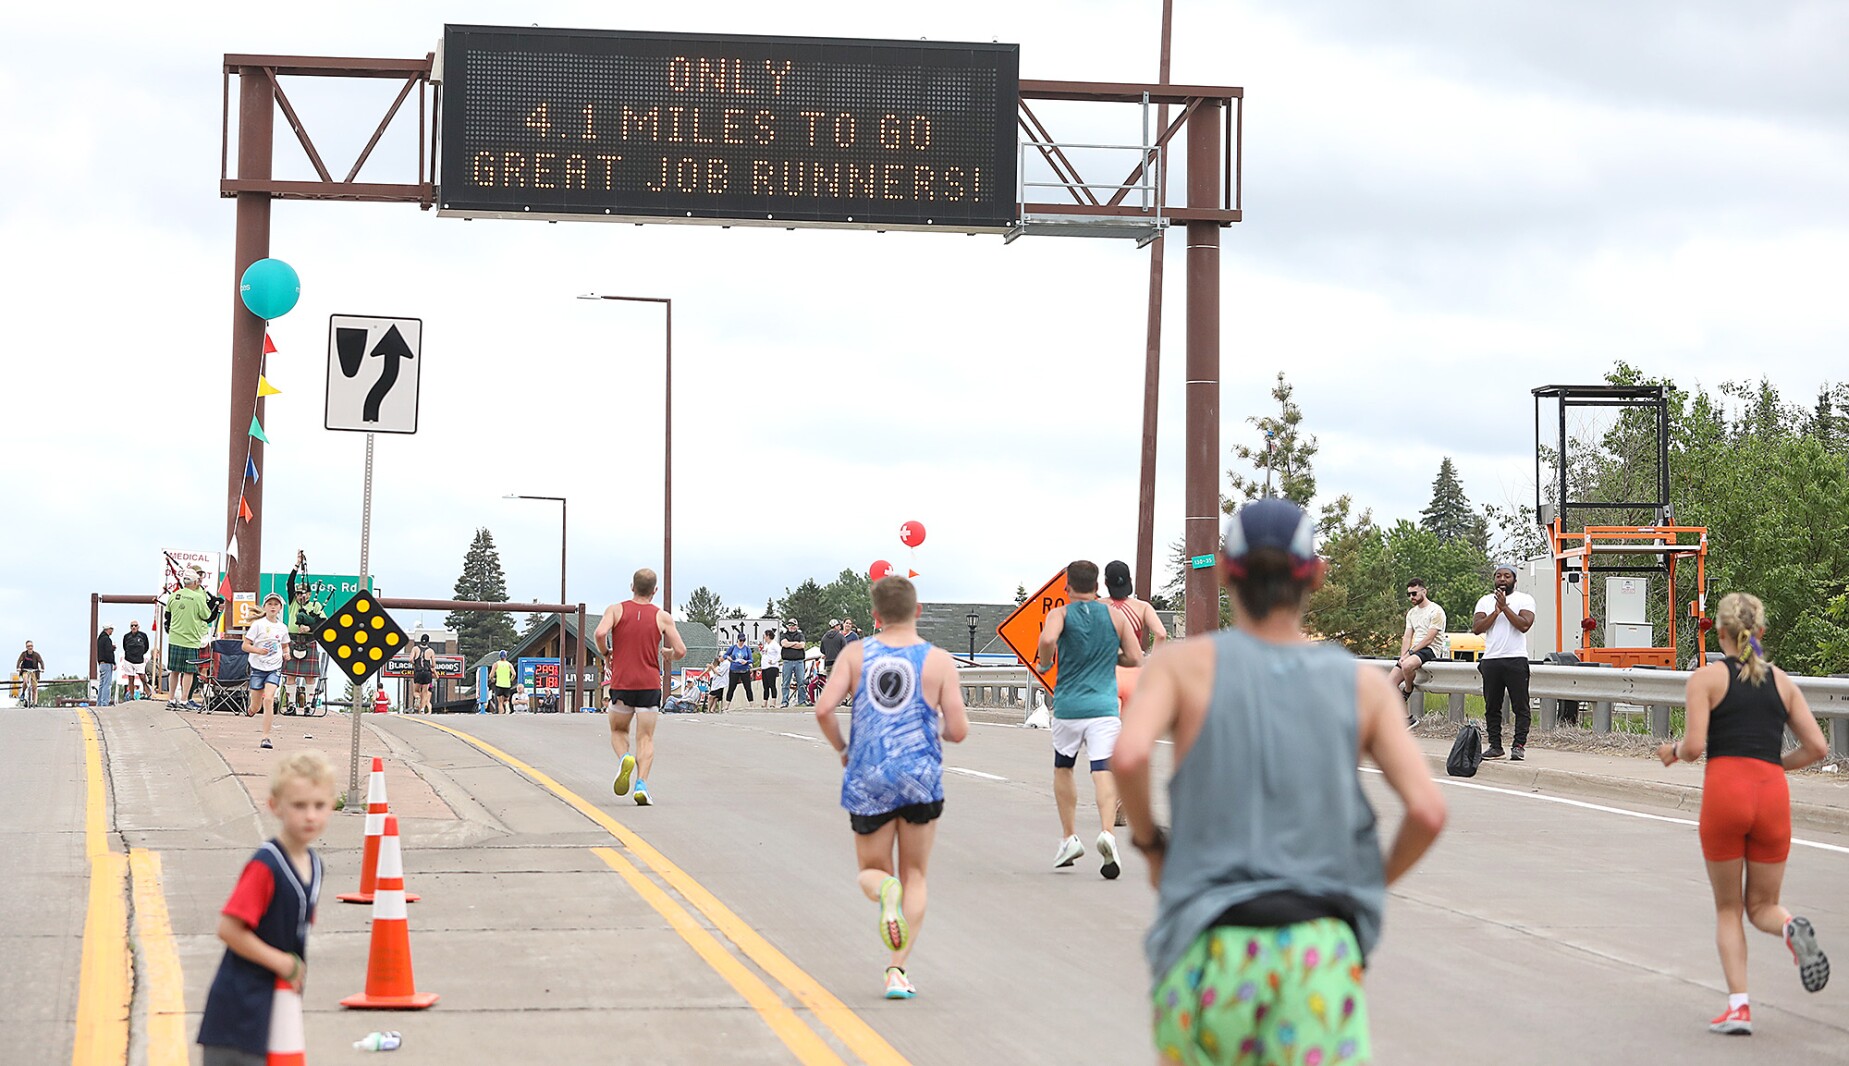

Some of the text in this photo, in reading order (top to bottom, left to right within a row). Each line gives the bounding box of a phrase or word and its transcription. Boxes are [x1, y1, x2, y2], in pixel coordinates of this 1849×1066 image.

[668, 56, 791, 95] ONLY
[525, 102, 932, 150] 4.1 MILES TO GO
[472, 150, 981, 202] GREAT JOB RUNNERS!
[170, 552, 209, 562] MEDICAL
[341, 582, 358, 593] Rd
[240, 602, 249, 619] 9
[1042, 597, 1065, 614] RO
